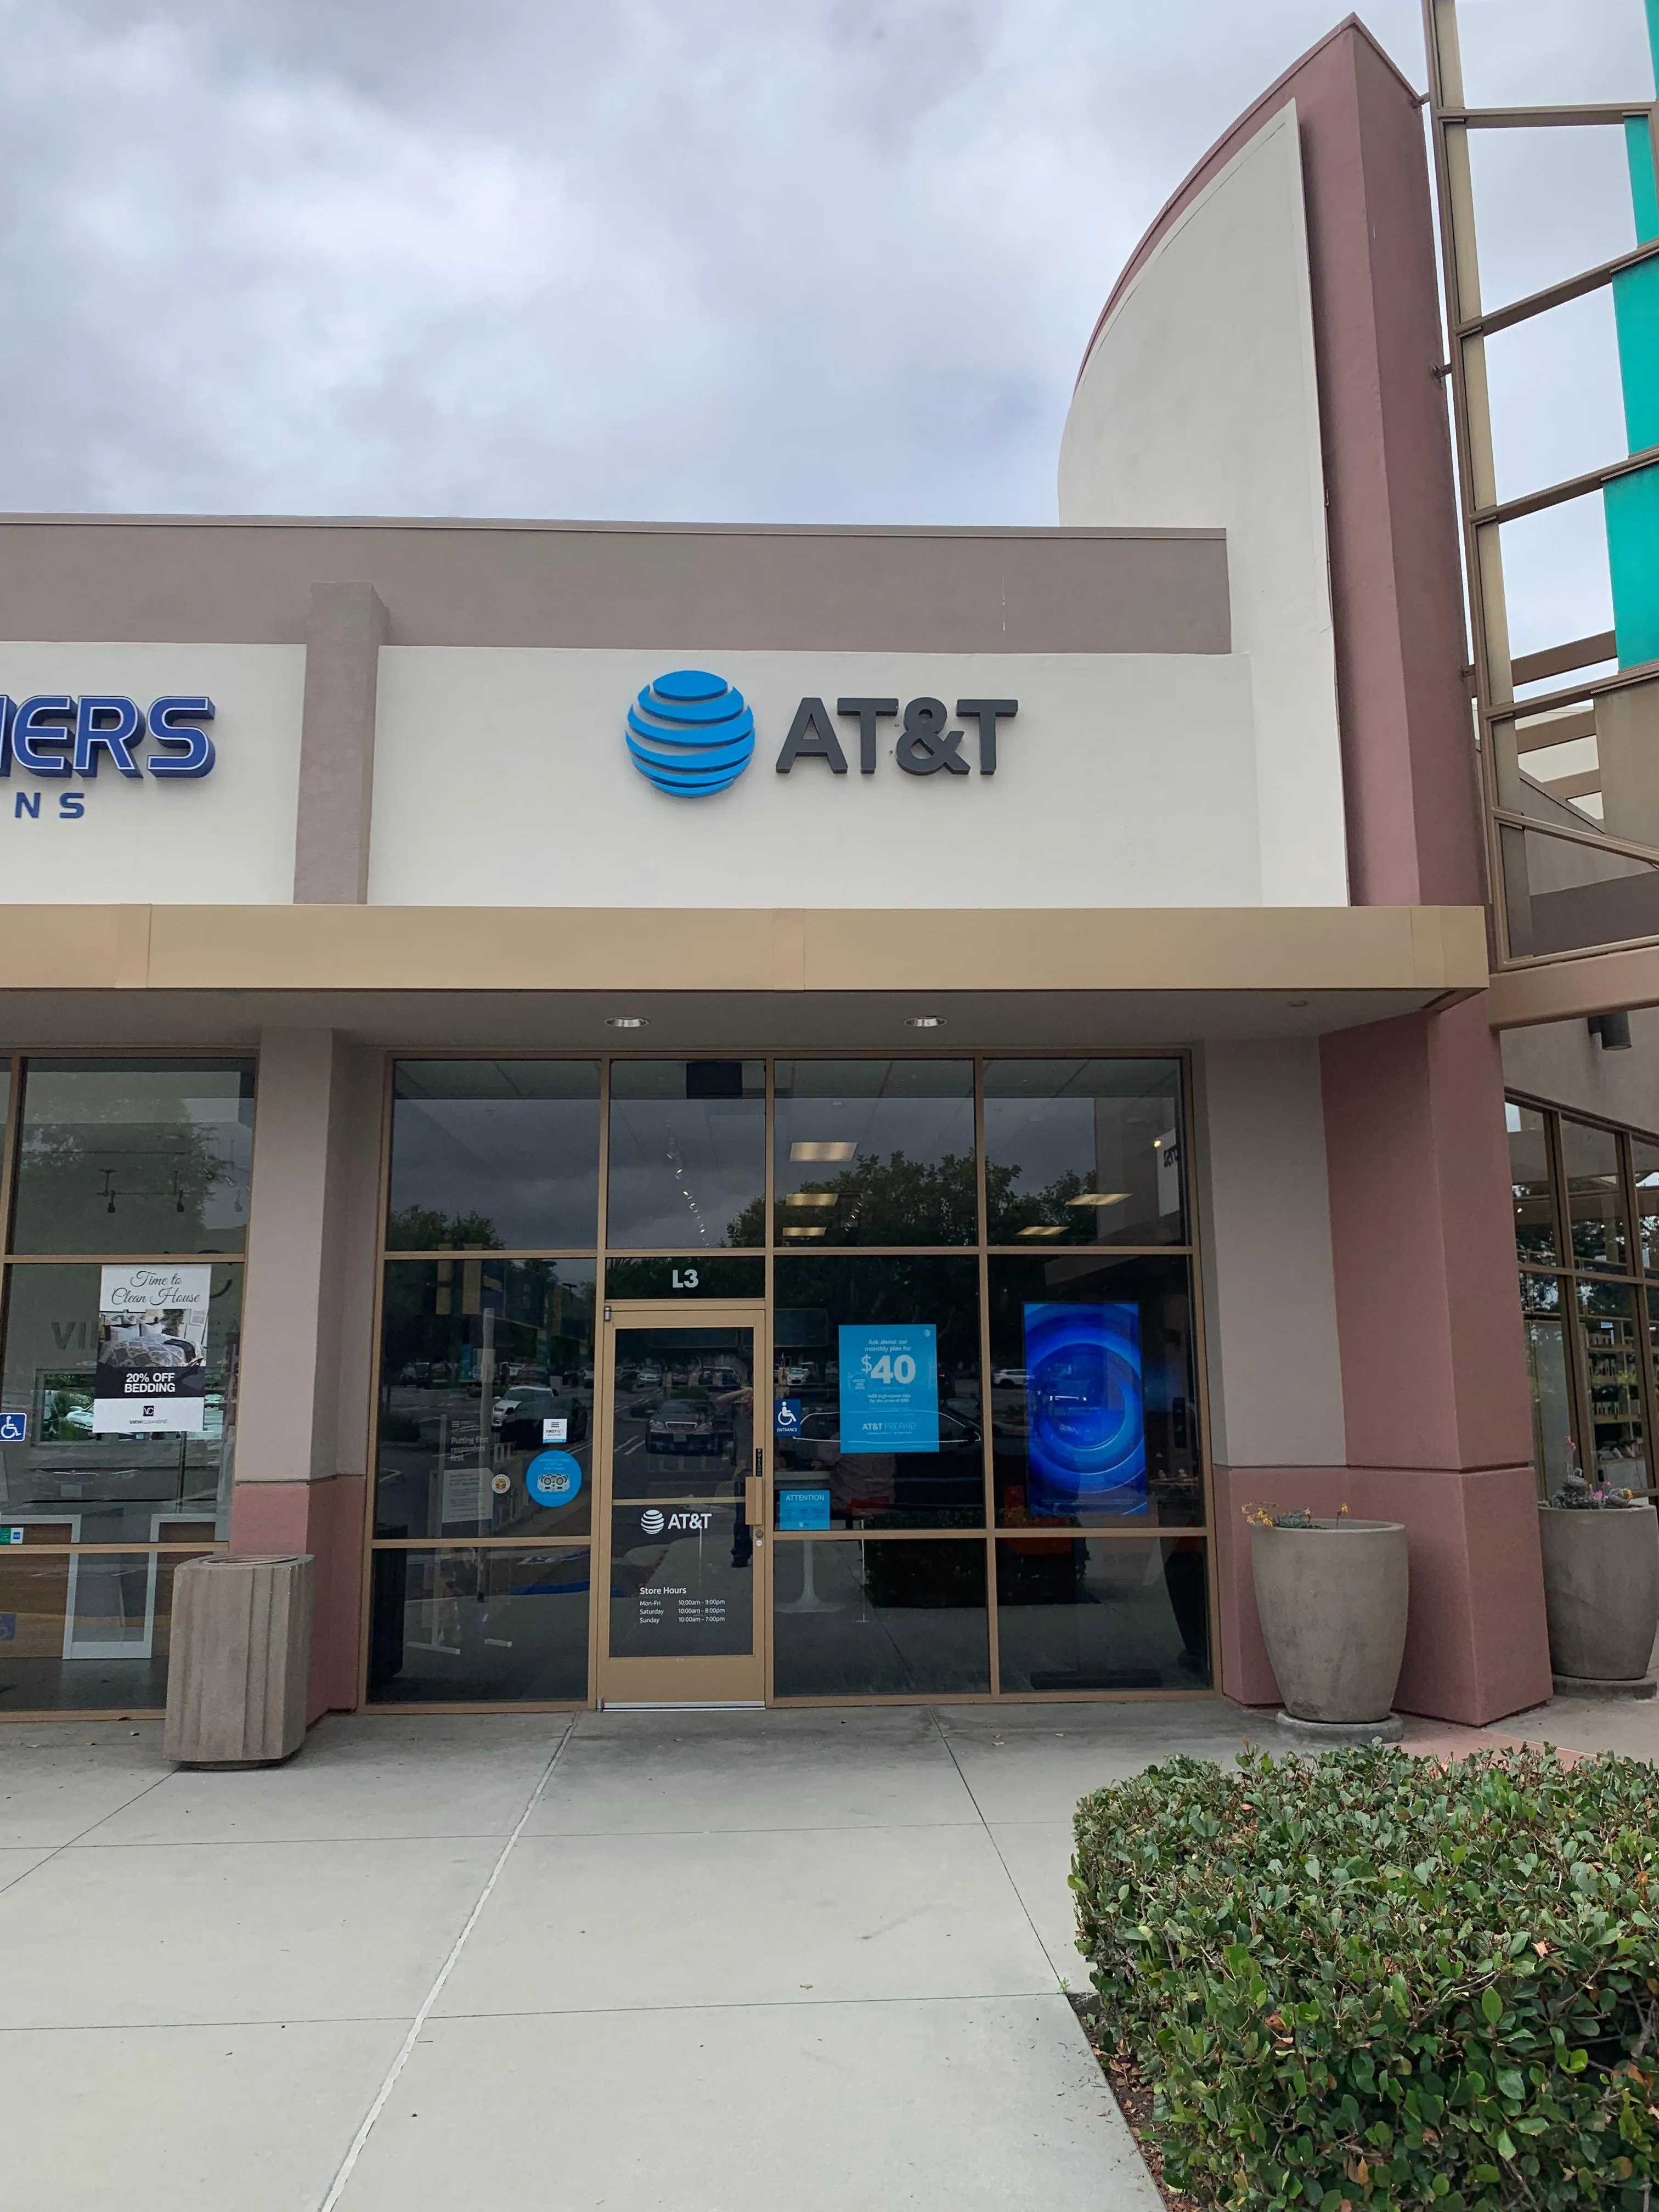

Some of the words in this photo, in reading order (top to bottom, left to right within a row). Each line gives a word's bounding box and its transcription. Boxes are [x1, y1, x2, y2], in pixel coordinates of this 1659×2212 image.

[775, 697, 1018, 776] AT&T
[15, 792, 84, 818] NS
[131, 1271, 167, 1287] Time
[171, 1273, 182, 1285] to
[673, 1269, 698, 1288] L3
[111, 1287, 146, 1305] Clean
[149, 1286, 200, 1306] House
[861, 1354, 916, 1384] $40
[126, 1373, 150, 1383] 20%
[153, 1373, 176, 1382] OFF
[124, 1383, 176, 1393] BEDDING
[884, 1422, 916, 1430] PREPAID
[451, 1436, 474, 1444] Putting
[667, 1513, 712, 1530] AT&T
